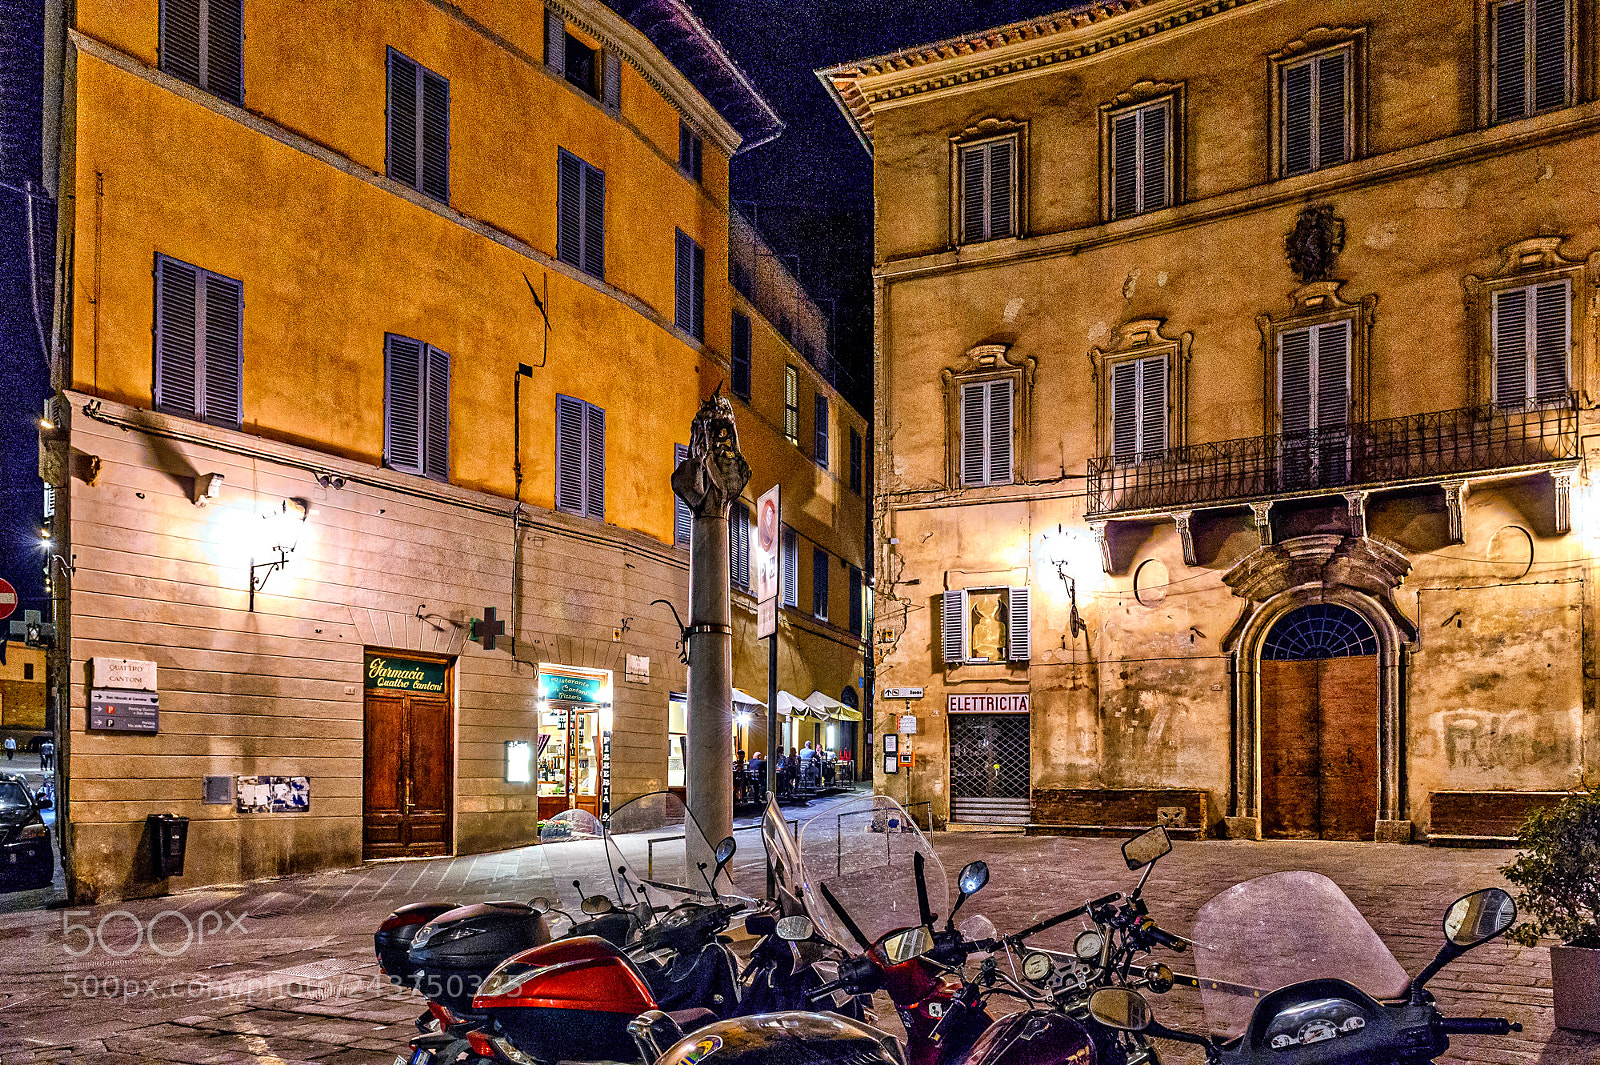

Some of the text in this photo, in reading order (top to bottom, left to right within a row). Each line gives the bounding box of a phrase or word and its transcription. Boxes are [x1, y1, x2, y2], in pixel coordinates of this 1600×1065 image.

[109, 664, 143, 672] QUATTRO
[369, 658, 424, 680] Farmacia
[377, 677, 443, 691] Quattro Cantoni
[550, 677, 590, 688] Ristorante
[603, 736, 611, 803] PIZZERIA
